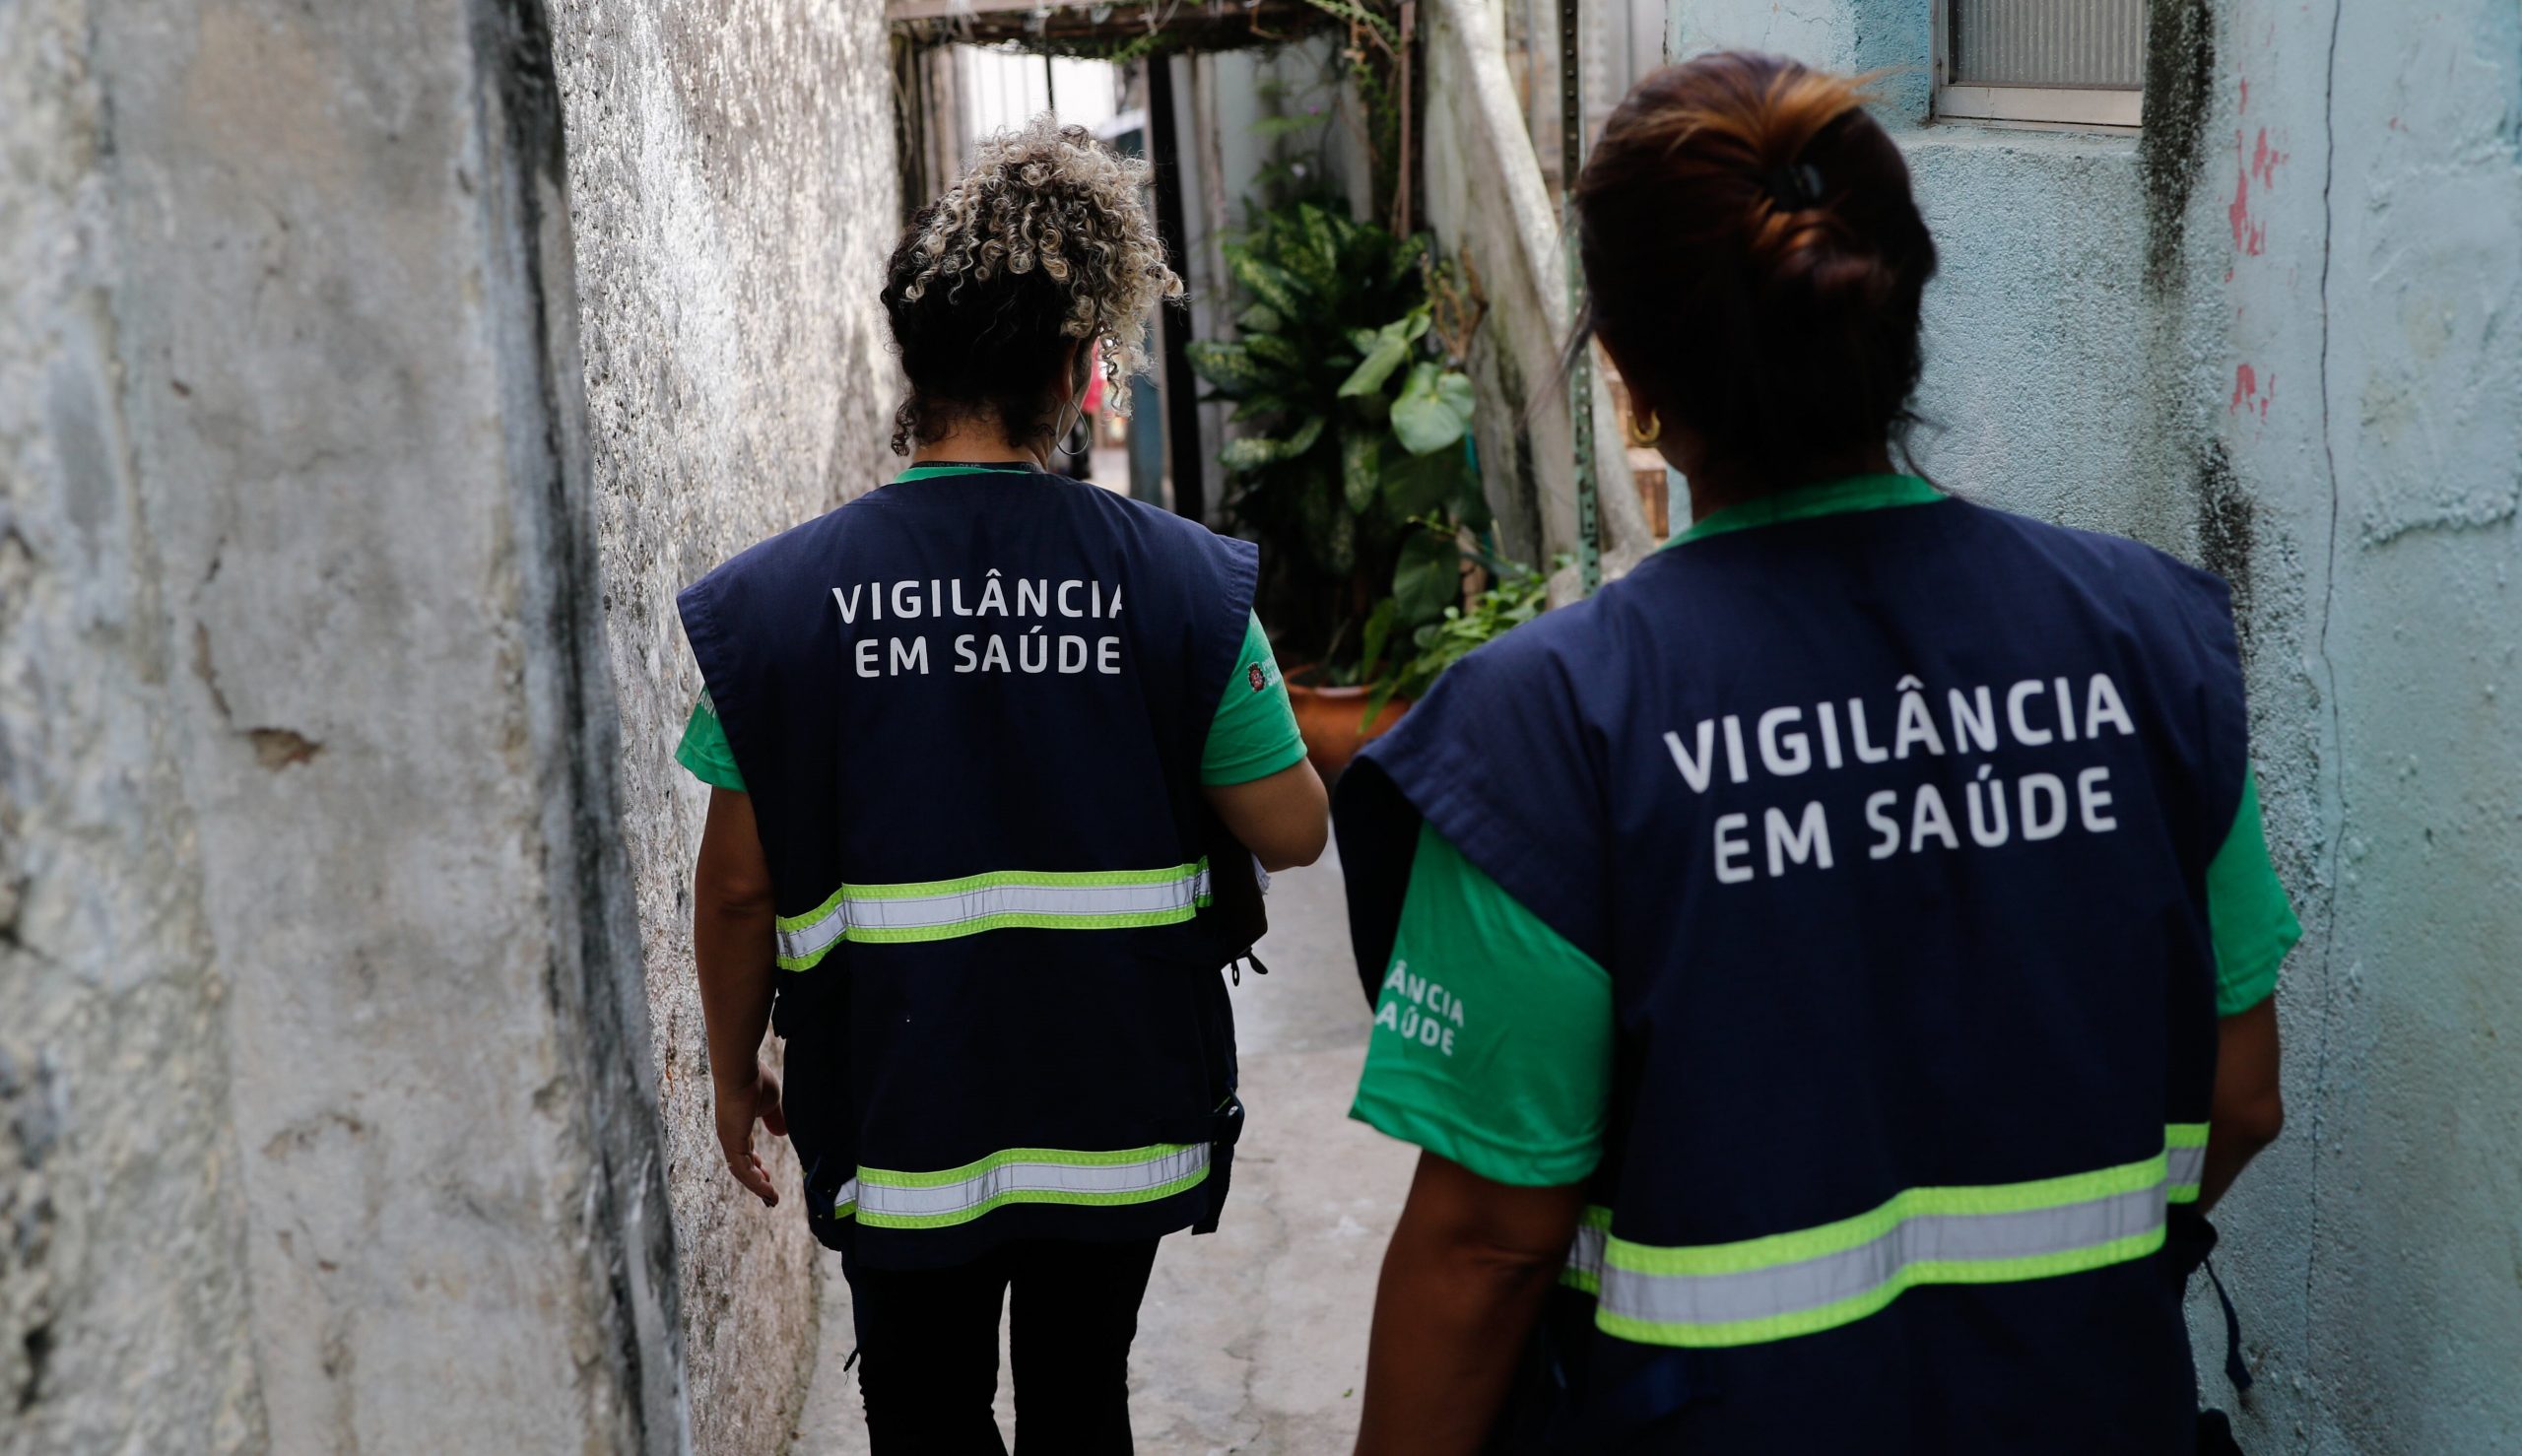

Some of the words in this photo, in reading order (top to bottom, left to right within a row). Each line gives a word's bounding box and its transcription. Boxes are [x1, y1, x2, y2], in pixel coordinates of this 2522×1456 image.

[855, 636, 929, 678] EM
[954, 626, 1121, 675] SAÚDE
[1663, 674, 2136, 793] VIGILÂNCIA
[1714, 801, 1833, 884] EM
[1866, 764, 2117, 859] SAÚDE
